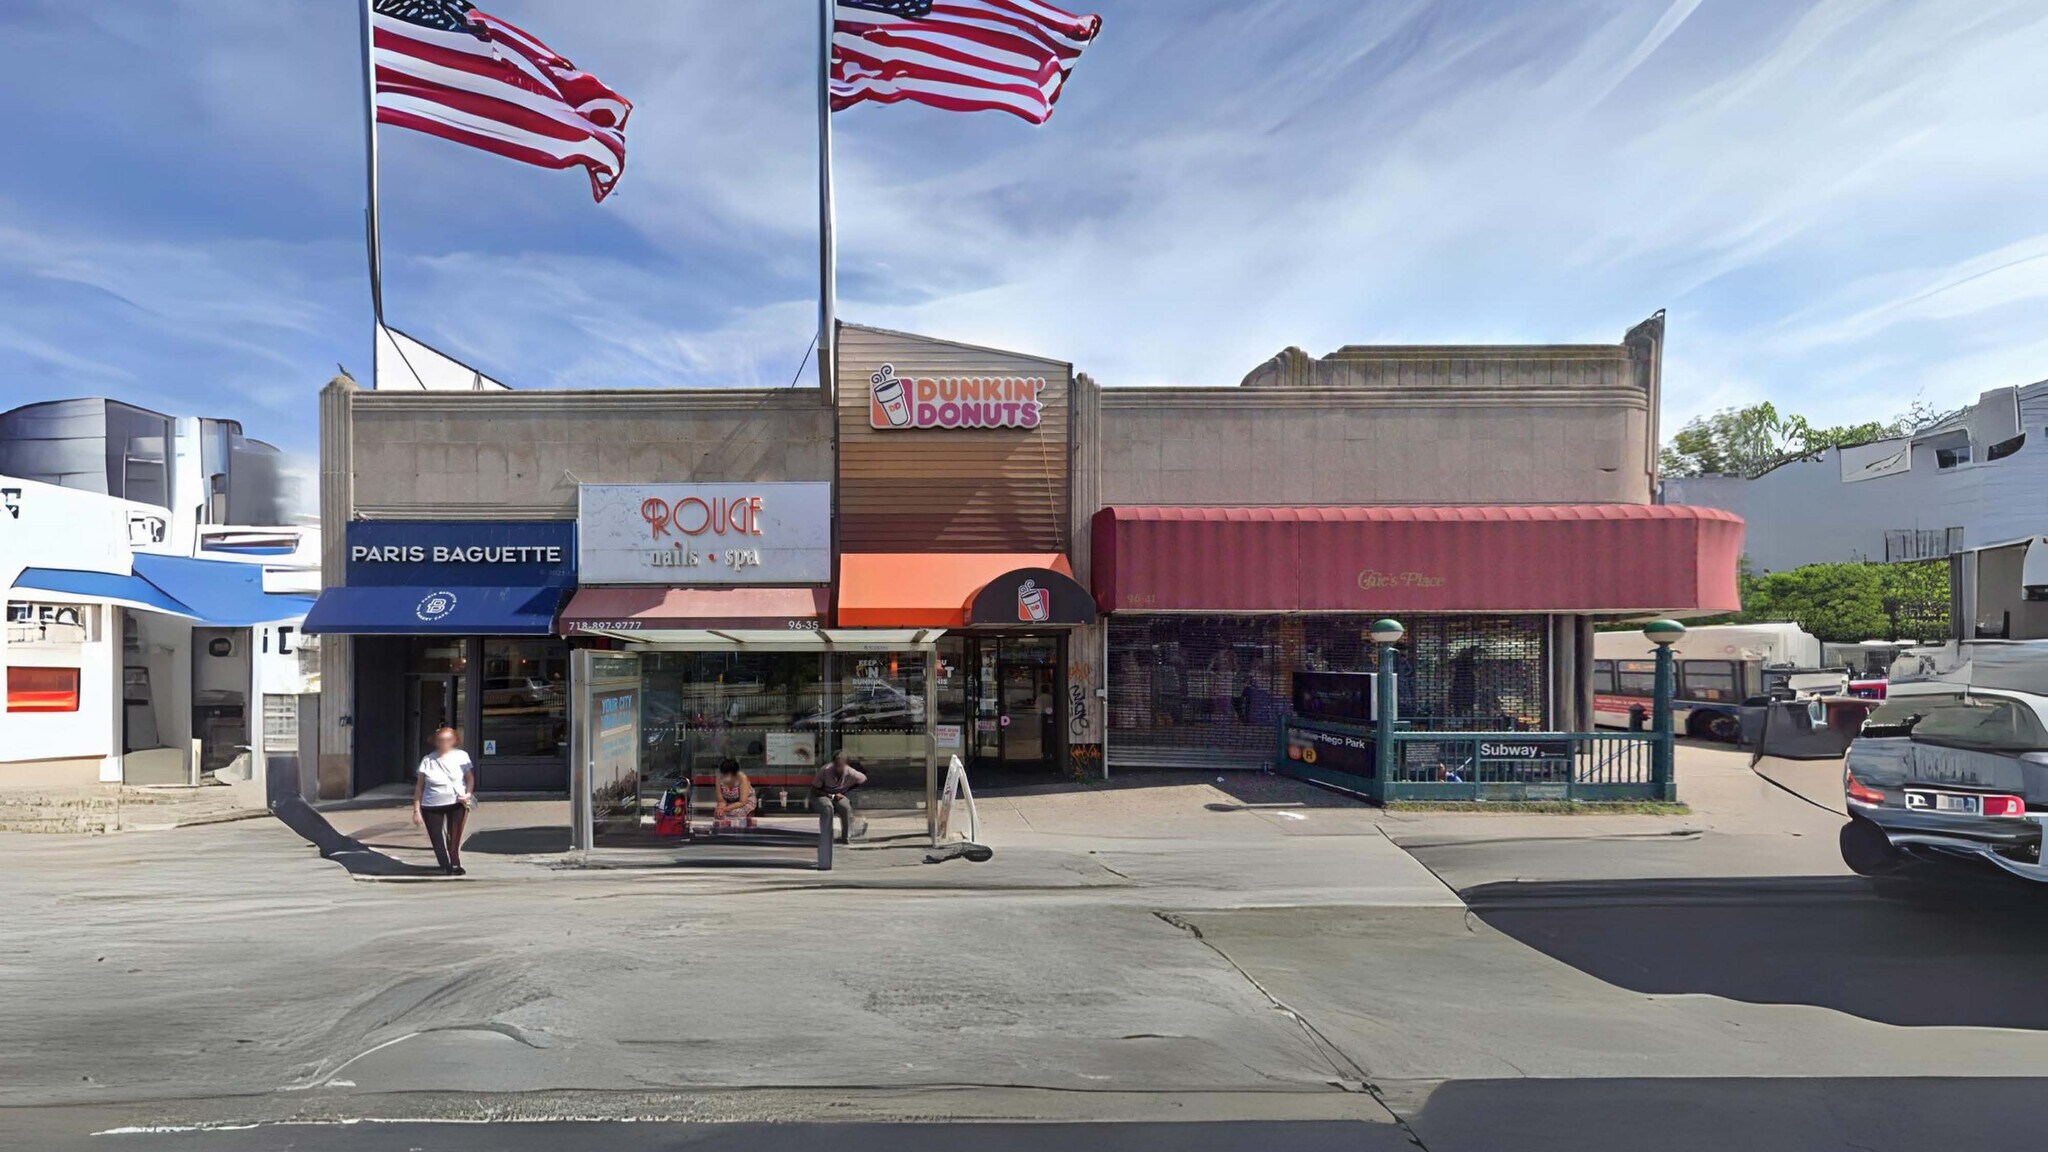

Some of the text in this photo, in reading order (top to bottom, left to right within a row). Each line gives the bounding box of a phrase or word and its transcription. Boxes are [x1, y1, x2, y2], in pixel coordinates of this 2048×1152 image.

[917, 378, 1045, 401] DUNKIN'
[917, 402, 1038, 426] DONUTS
[641, 496, 762, 539] ROUGE
[351, 546, 561, 562] PARIS BAGUETTE
[651, 541, 760, 571] nails spa
[1400, 571, 1445, 588] Place
[568, 620, 819, 630] 718-897-9777 96-35
[1345, 738, 1366, 749] Park
[1480, 743, 1538, 758] Subway
[1306, 750, 1313, 760] R
